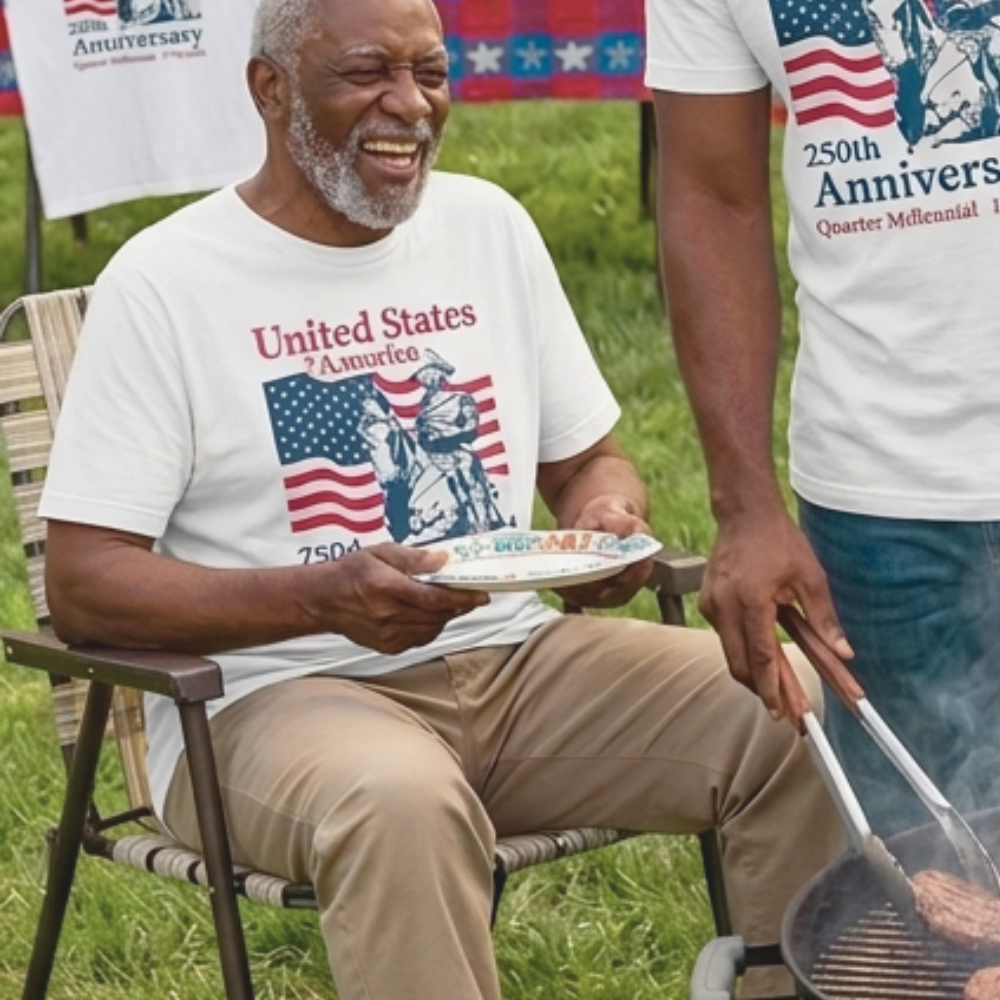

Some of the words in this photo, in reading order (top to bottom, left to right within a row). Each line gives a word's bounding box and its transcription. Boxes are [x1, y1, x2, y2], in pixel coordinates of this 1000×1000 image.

[803, 136, 882, 168] 250th
[251, 310, 375, 361] United
[381, 303, 477, 340] States
